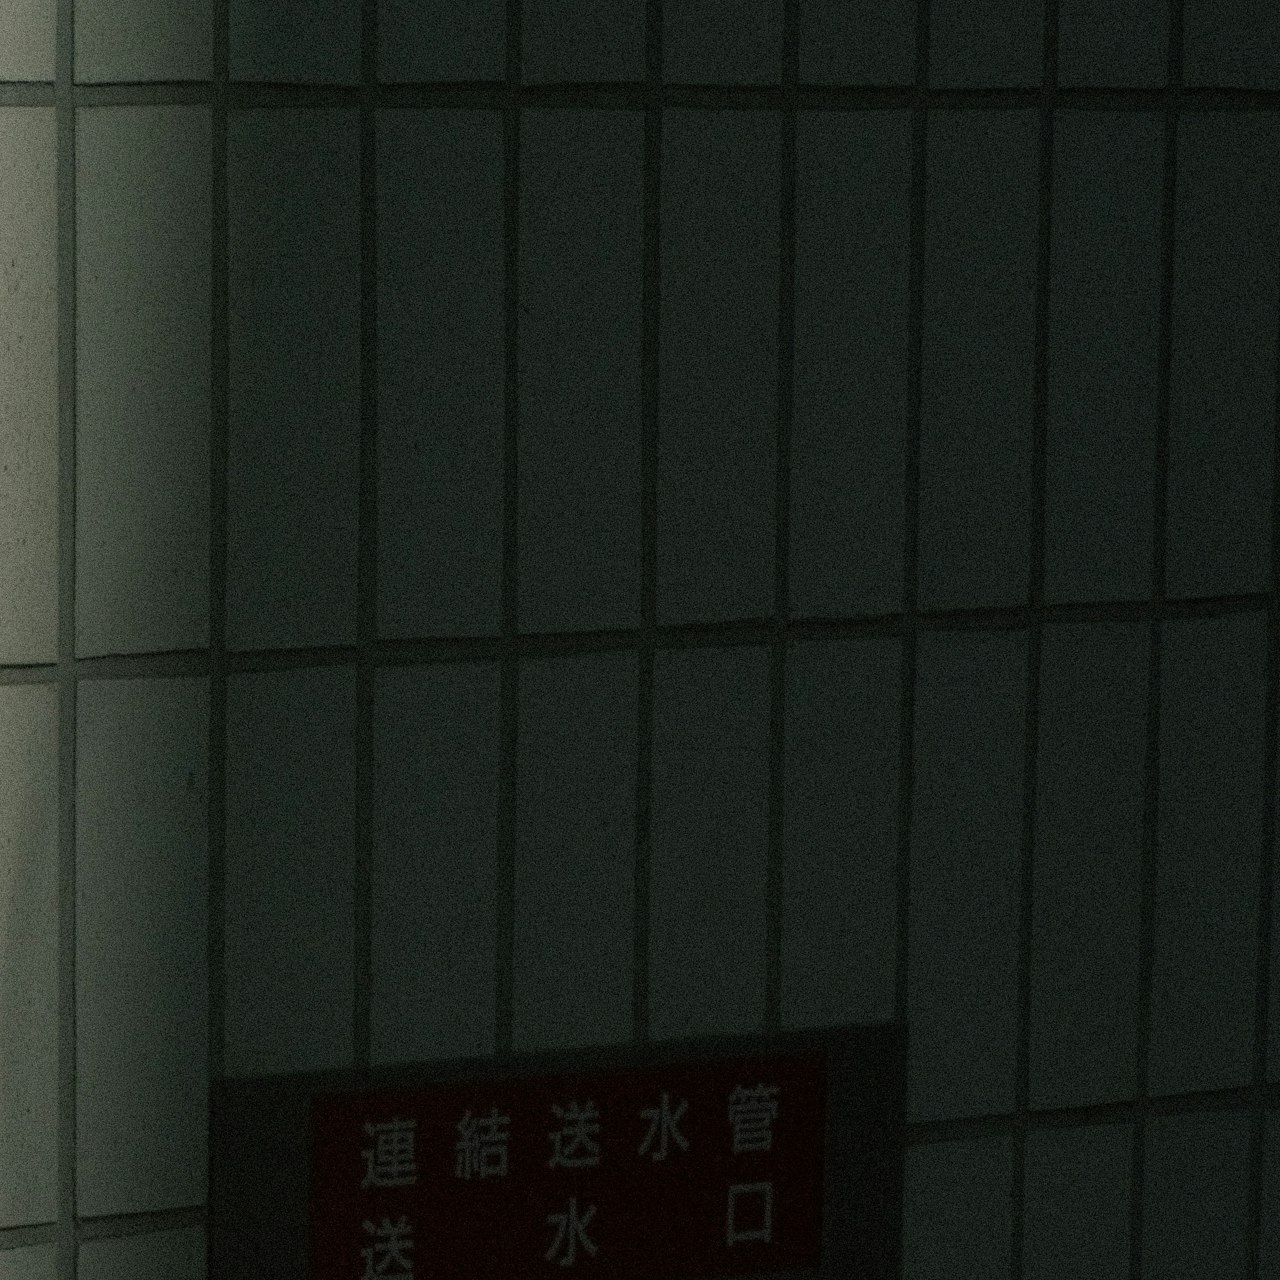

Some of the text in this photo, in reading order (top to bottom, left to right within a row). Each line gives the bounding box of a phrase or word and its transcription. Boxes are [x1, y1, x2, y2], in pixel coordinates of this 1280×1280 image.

[360, 1082, 783, 1190] 連結送水管
